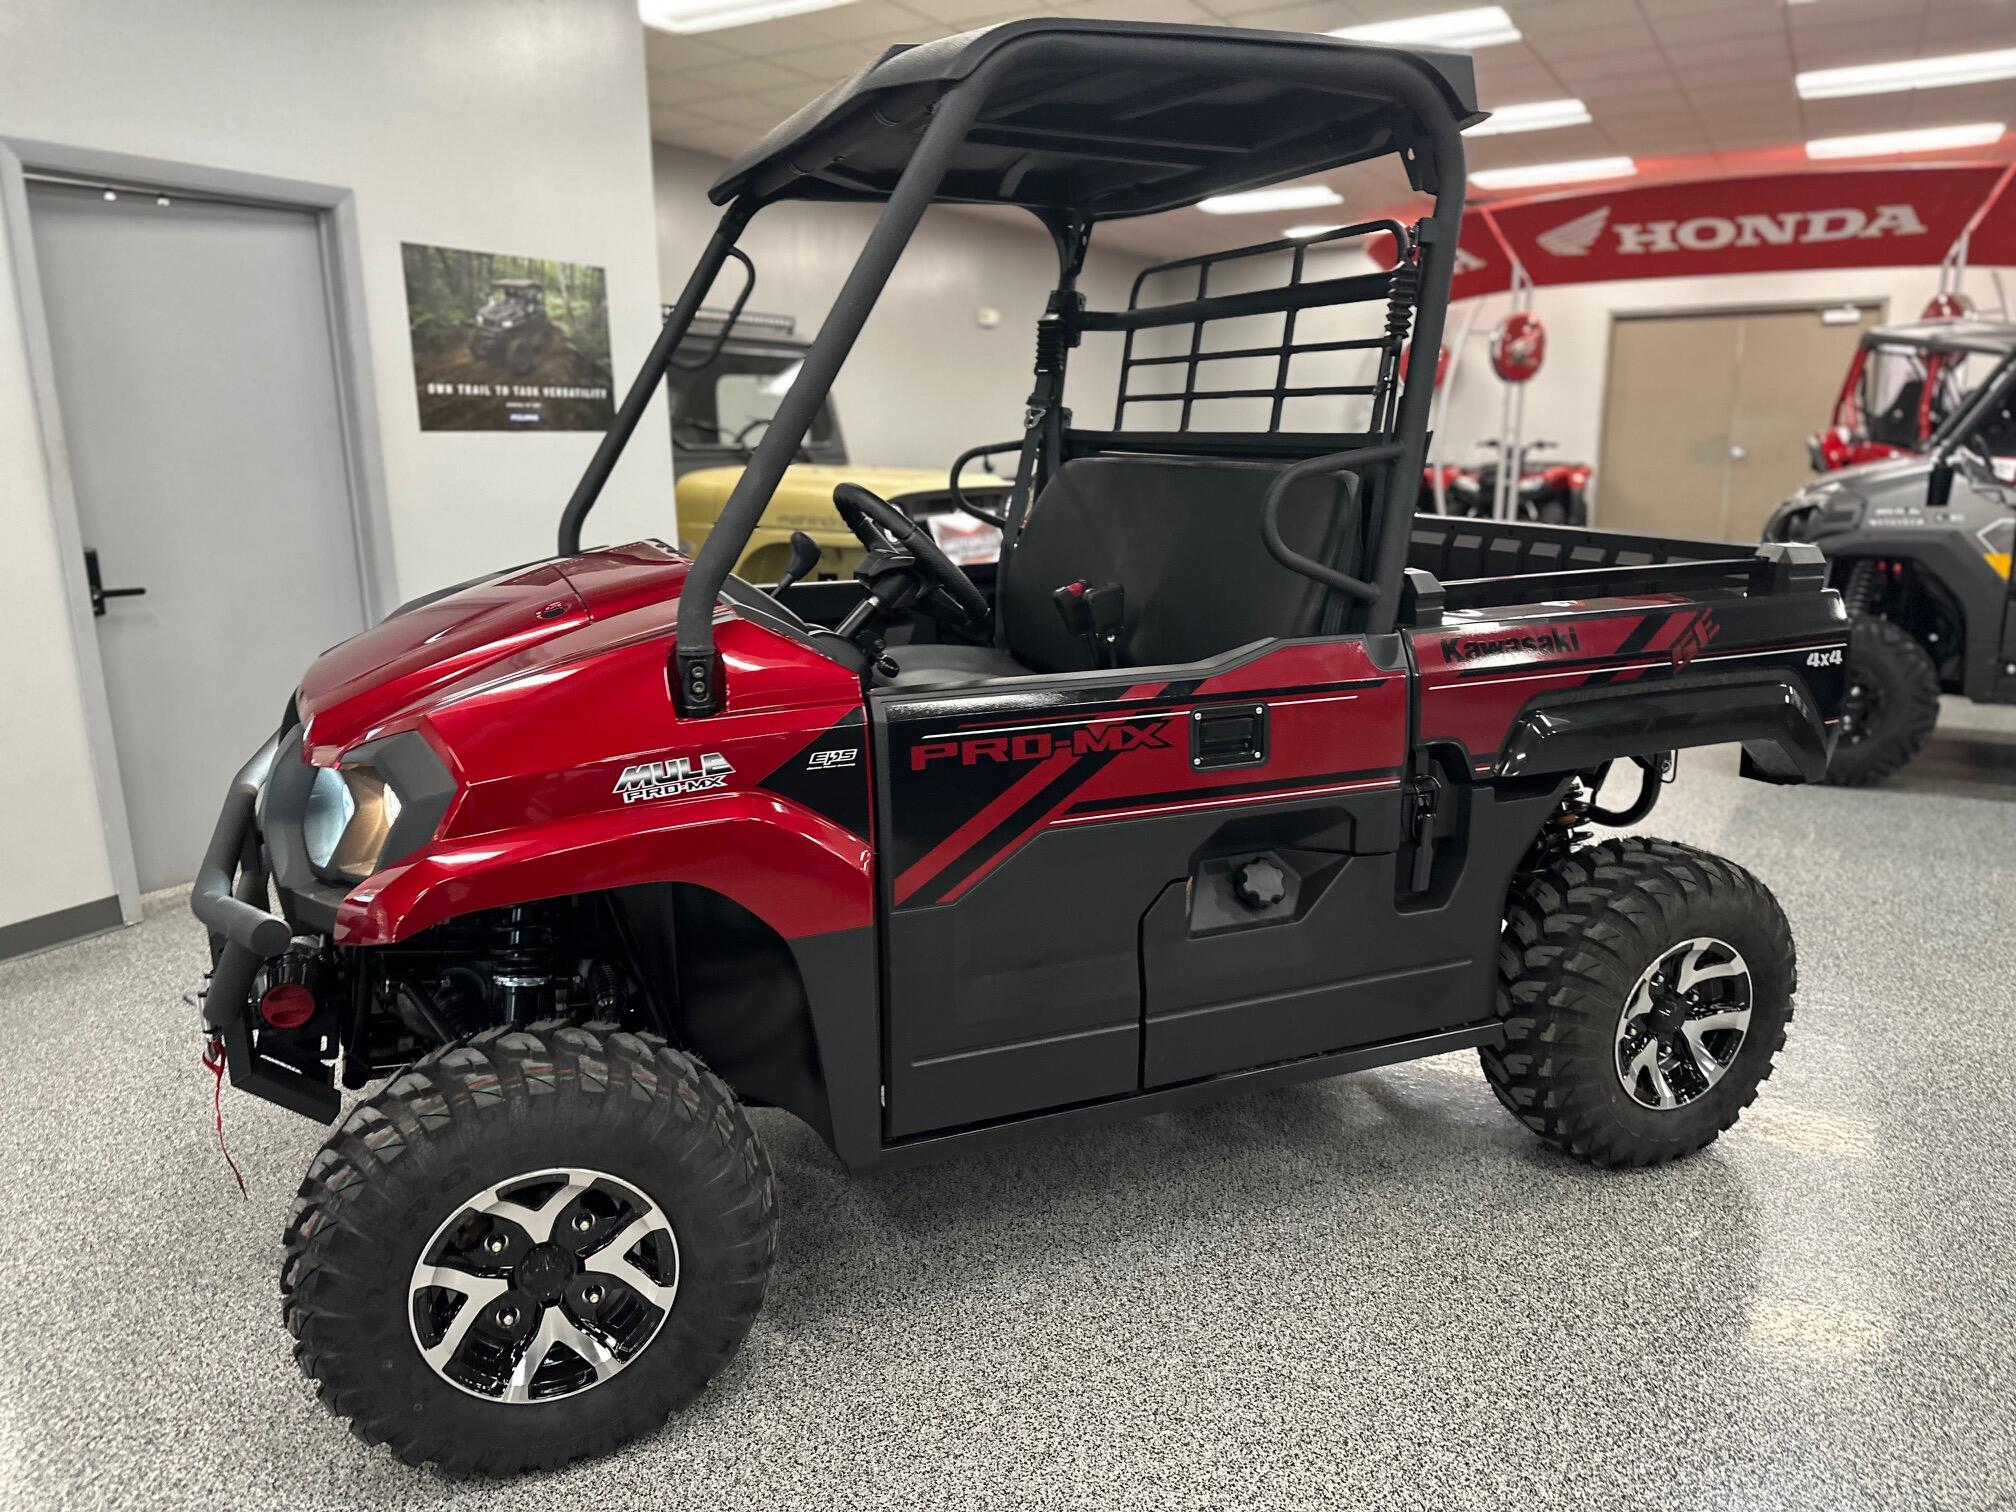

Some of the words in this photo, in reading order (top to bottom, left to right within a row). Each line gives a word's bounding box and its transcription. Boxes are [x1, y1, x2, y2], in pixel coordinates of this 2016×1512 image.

[1612, 203, 1928, 254] HONDA
[427, 383, 453, 395] OWN
[457, 384, 491, 396] TRAIL
[495, 385, 509, 396] TO
[513, 386, 540, 397] TASK
[543, 387, 607, 399] VERSATILITY
[1440, 626, 1580, 664] Kawasaki
[1806, 649, 1843, 667] 4x4
[809, 748, 858, 766] EPS
[911, 718, 1175, 771] PRO-MX
[612, 752, 736, 793] MULE
[623, 774, 728, 804] PRO-MX
